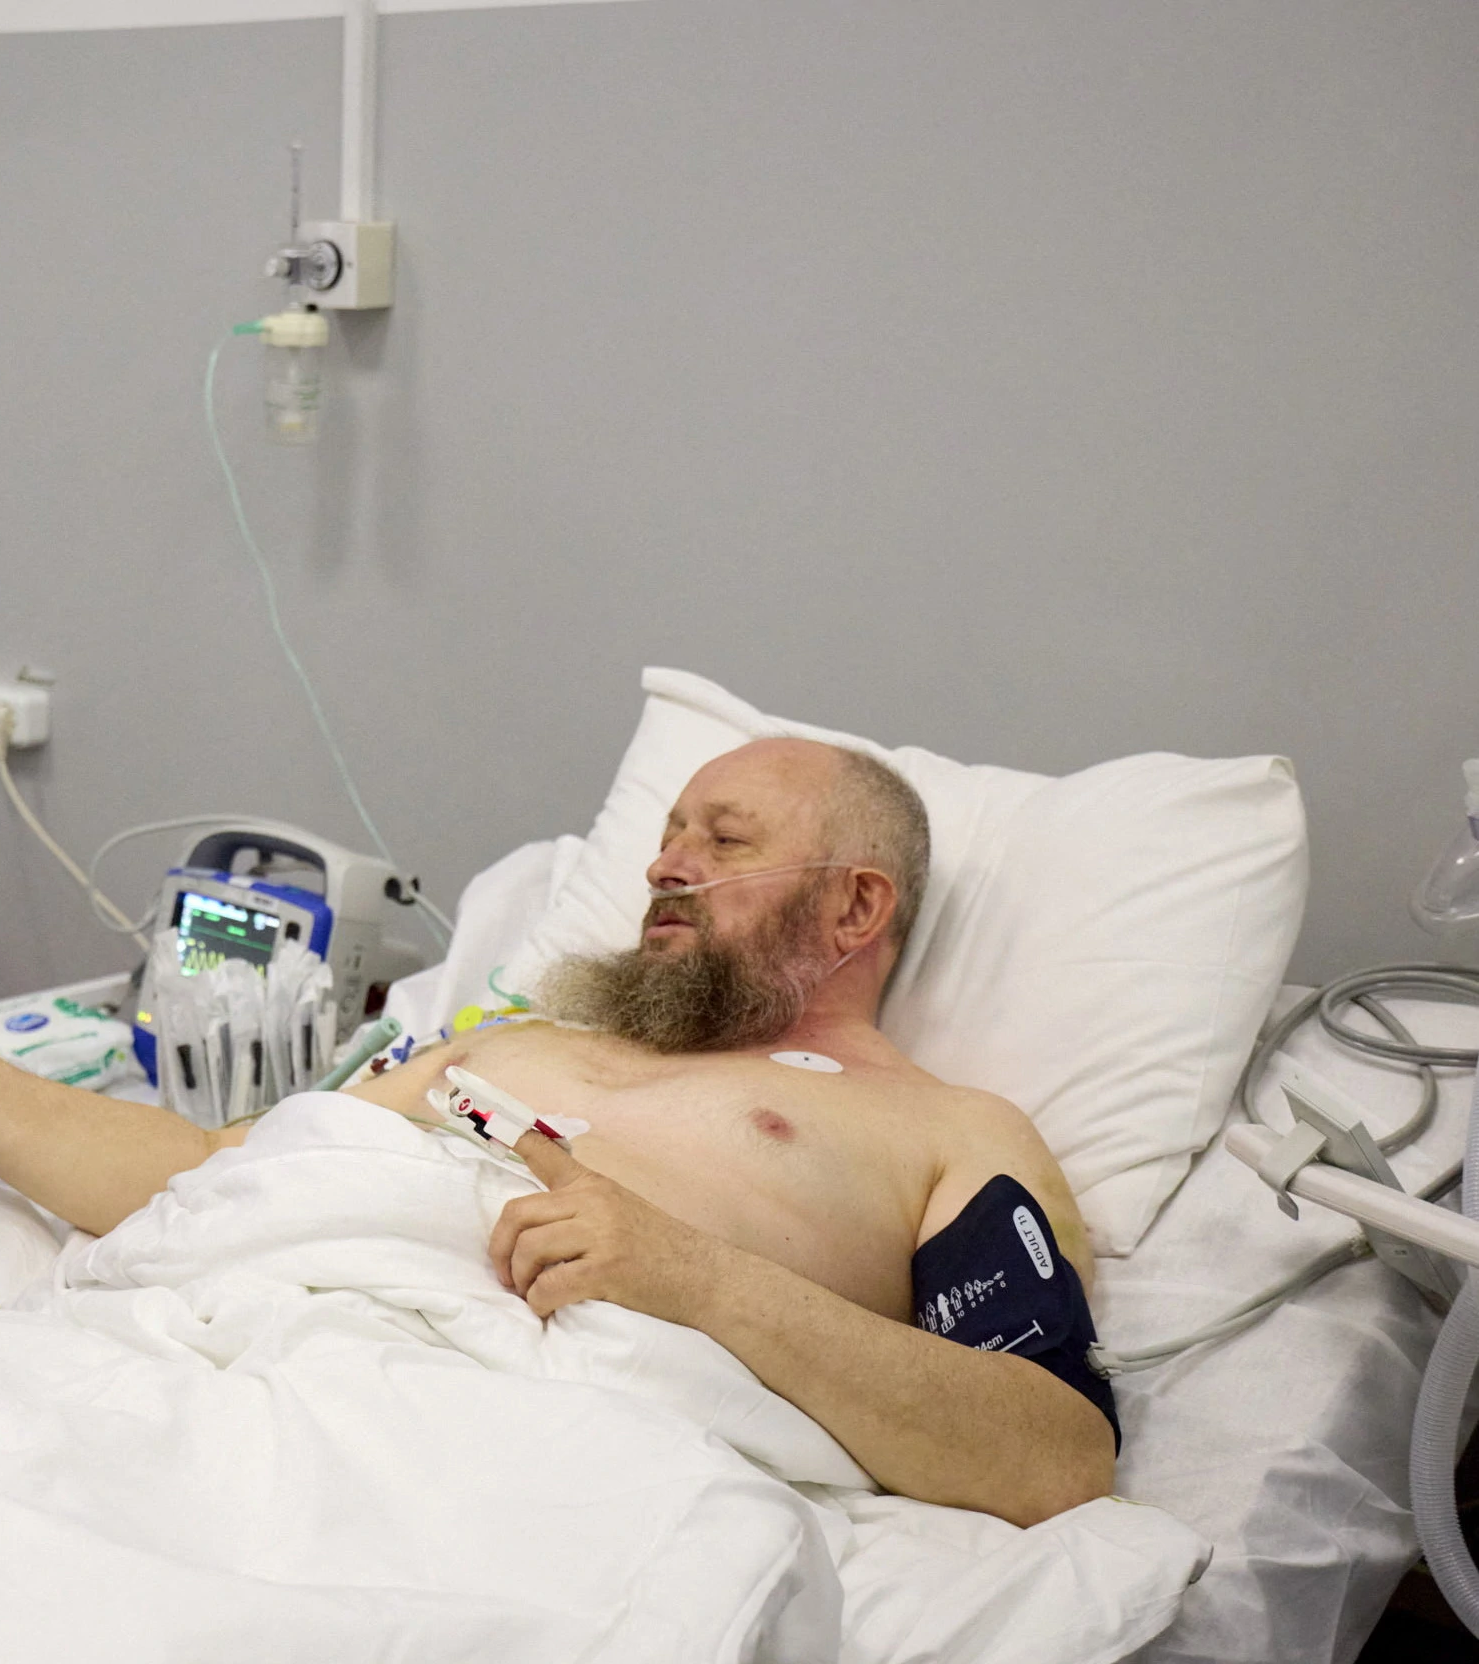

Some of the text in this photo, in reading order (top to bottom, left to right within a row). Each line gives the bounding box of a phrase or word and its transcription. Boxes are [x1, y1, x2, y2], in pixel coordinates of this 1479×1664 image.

[1017, 1214, 1049, 1268] ADULT 11
[956, 1309, 965, 1319] 10
[999, 1280, 1007, 1288] 6
